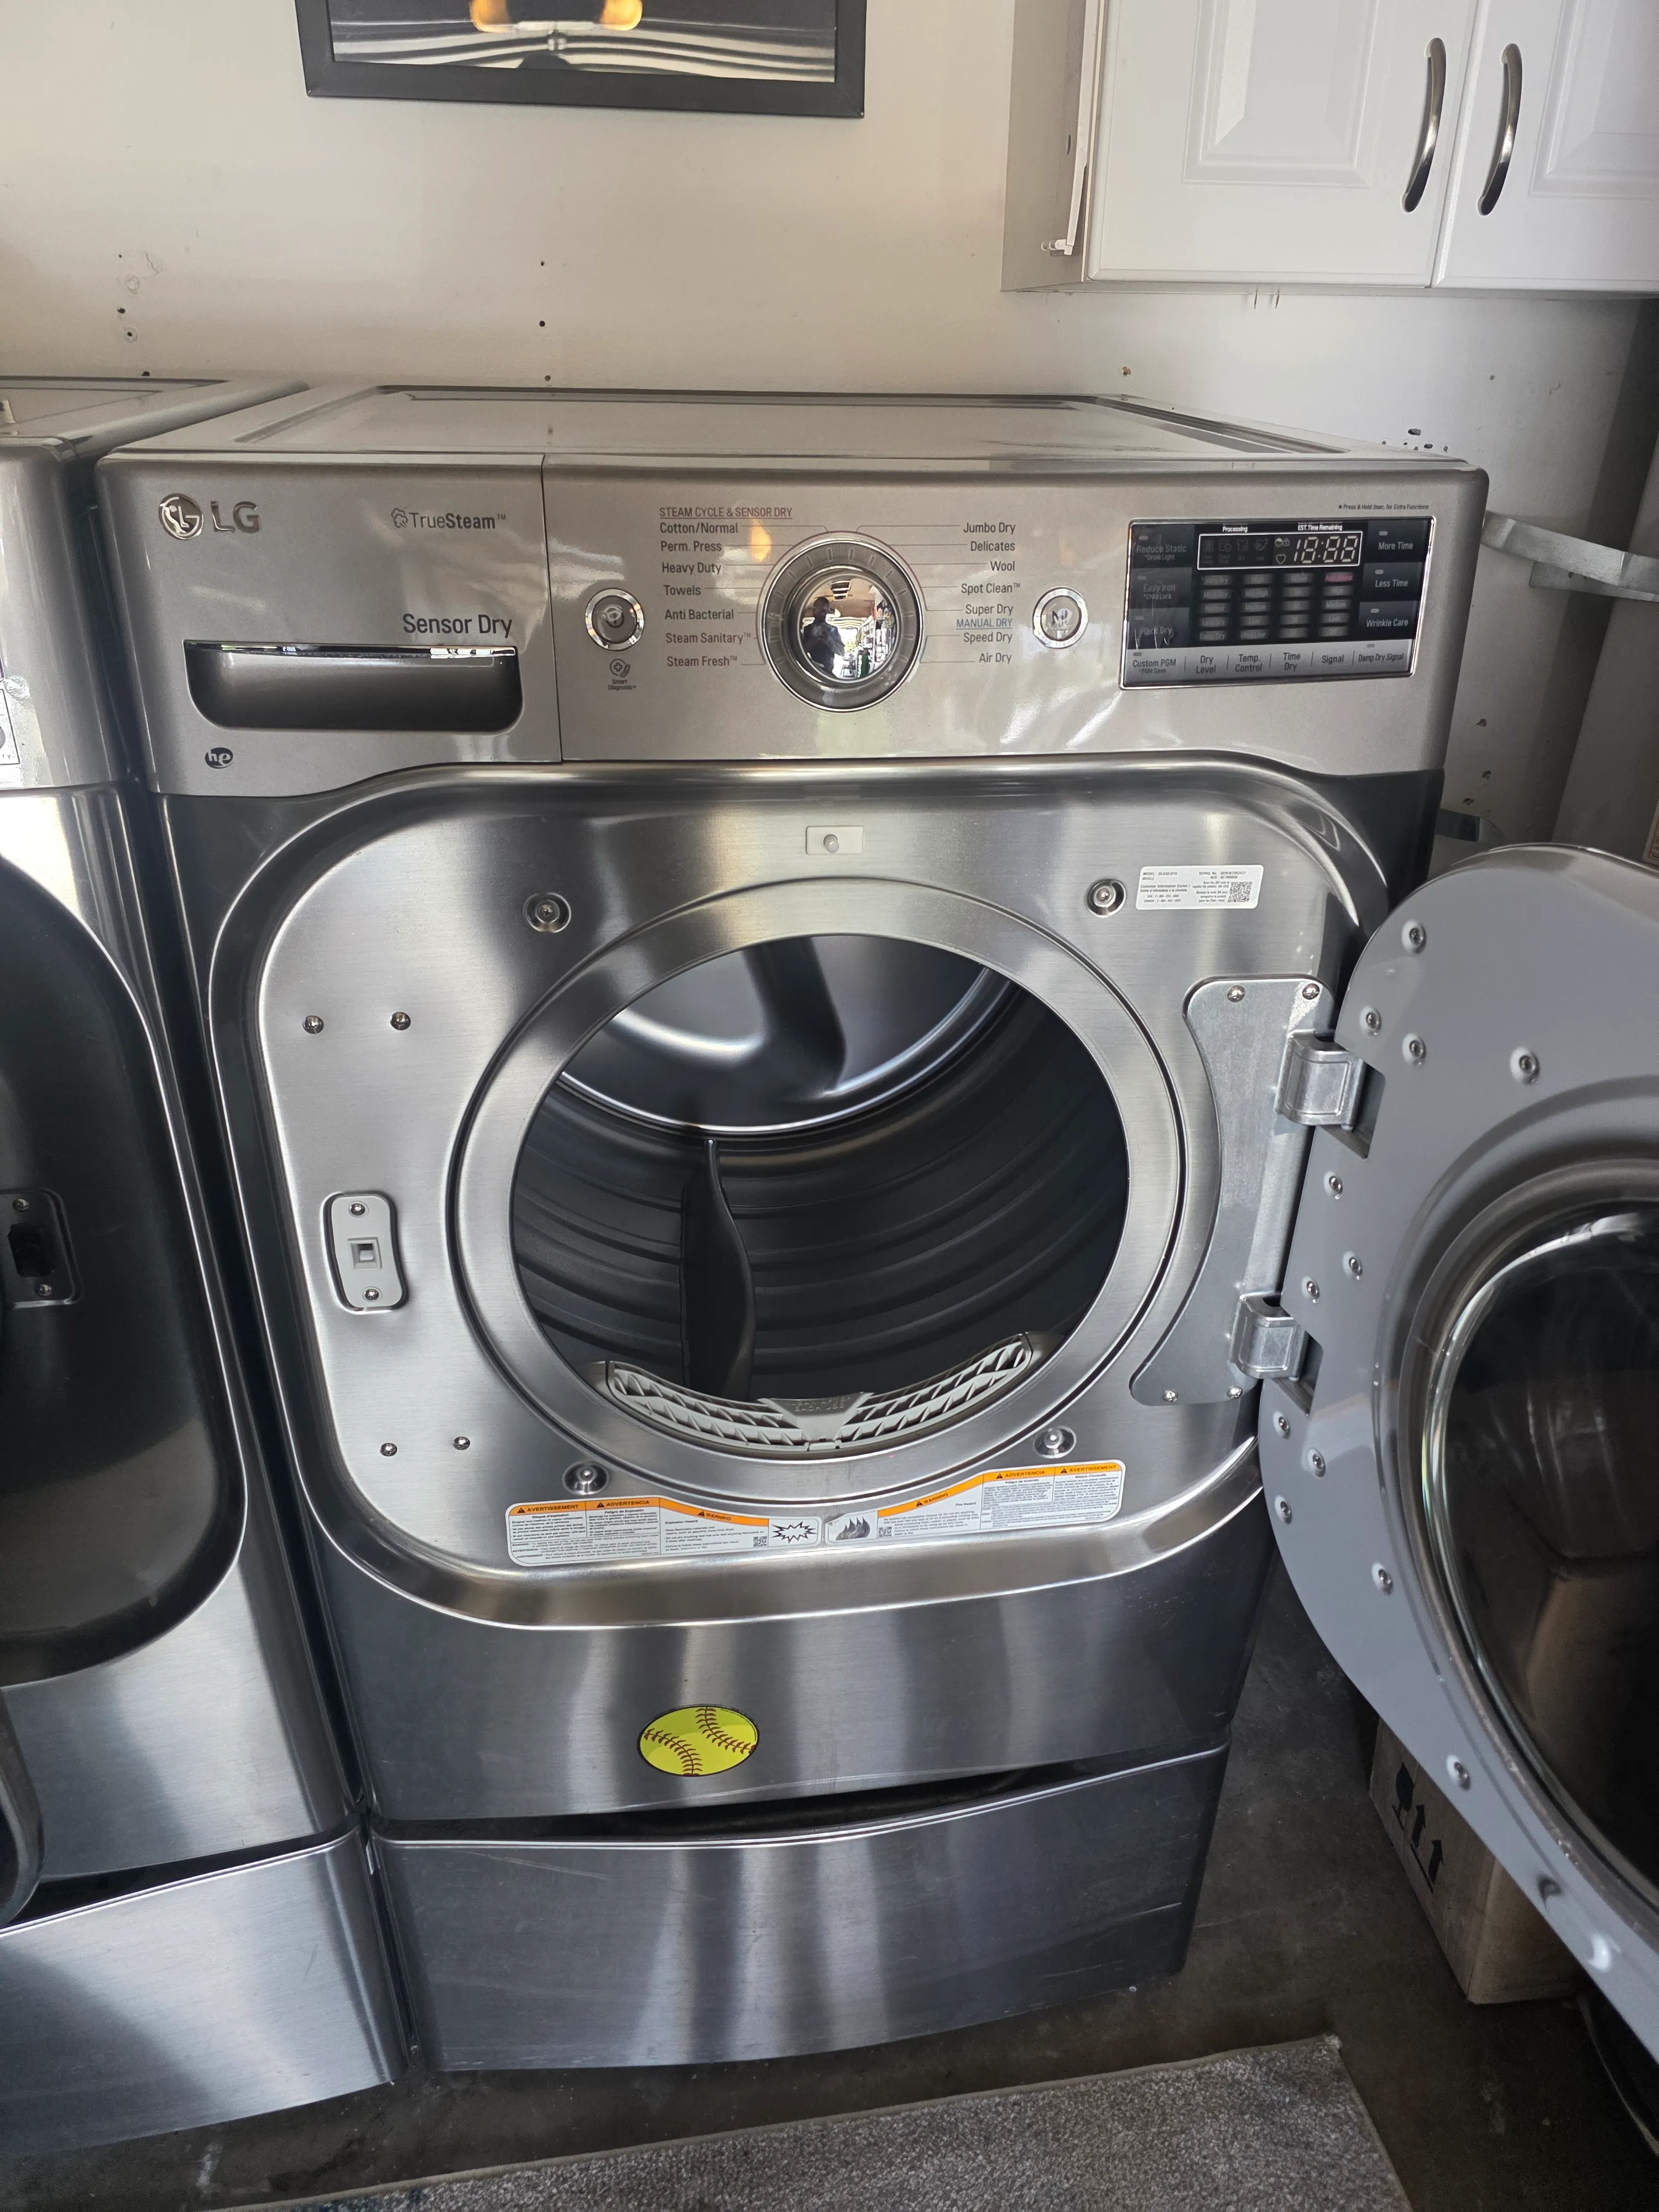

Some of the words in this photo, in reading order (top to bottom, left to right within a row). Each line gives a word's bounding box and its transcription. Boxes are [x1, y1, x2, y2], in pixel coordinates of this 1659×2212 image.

[210, 500, 261, 533] LG
[660, 508, 692, 517] STEAM
[695, 507, 724, 517] CYCLE
[727, 508, 733, 517] &
[735, 507, 771, 517] SENSOR
[775, 507, 792, 517] DRY
[660, 523, 738, 534] Cotton/Normal
[963, 522, 996, 533] Jumbo
[999, 522, 1016, 535] Dry
[661, 541, 690, 551] Perm.
[693, 541, 722, 551] Press
[971, 541, 1015, 551] Delicates
[1136, 545, 1164, 553] Reduce
[1165, 544, 1187, 553] Static
[1378, 541, 1395, 550] More
[662, 562, 694, 575] Heavy
[698, 562, 721, 575] Duty
[990, 561, 1015, 571] Wool
[664, 585, 701, 596] Towels
[961, 583, 983, 596] Spot
[1143, 584, 1161, 593] Easy
[665, 609, 686, 620] Anti
[689, 609, 734, 619] Bacterial
[966, 604, 994, 616] Super
[997, 603, 1013, 616] Dry
[403, 613, 472, 634] Sensor
[478, 614, 513, 638] Dry
[956, 618, 994, 628] MANUAL
[996, 618, 1013, 627] DRY
[1366, 619, 1392, 628] Wrinkle
[1141, 627, 1158, 635] Rack
[1160, 627, 1173, 635] Dry
[666, 633, 698, 643] Steam
[963, 632, 993, 644] Speed
[996, 632, 1013, 644] Dry
[667, 656, 699, 667] Steam
[978, 653, 993, 662] Air
[995, 653, 1012, 664] Dry
[1200, 655, 1213, 664] Dry
[1239, 654, 1260, 663] Temp.
[1283, 653, 1301, 661] Time
[1321, 654, 1344, 665] Signal
[1358, 654, 1374, 663] Damp
[1375, 653, 1385, 662] Dry
[1386, 653, 1404, 662] Signal
[1161, 659, 1176, 667] PGM
[1235, 664, 1262, 672] Control
[1284, 662, 1297, 672] Dry
[1196, 665, 1216, 674] Level
[924, 1492, 948, 1504] WARNING
[527, 1504, 579, 1512] AVERTISSEMENT
[706, 1513, 732, 1521] WARNING
